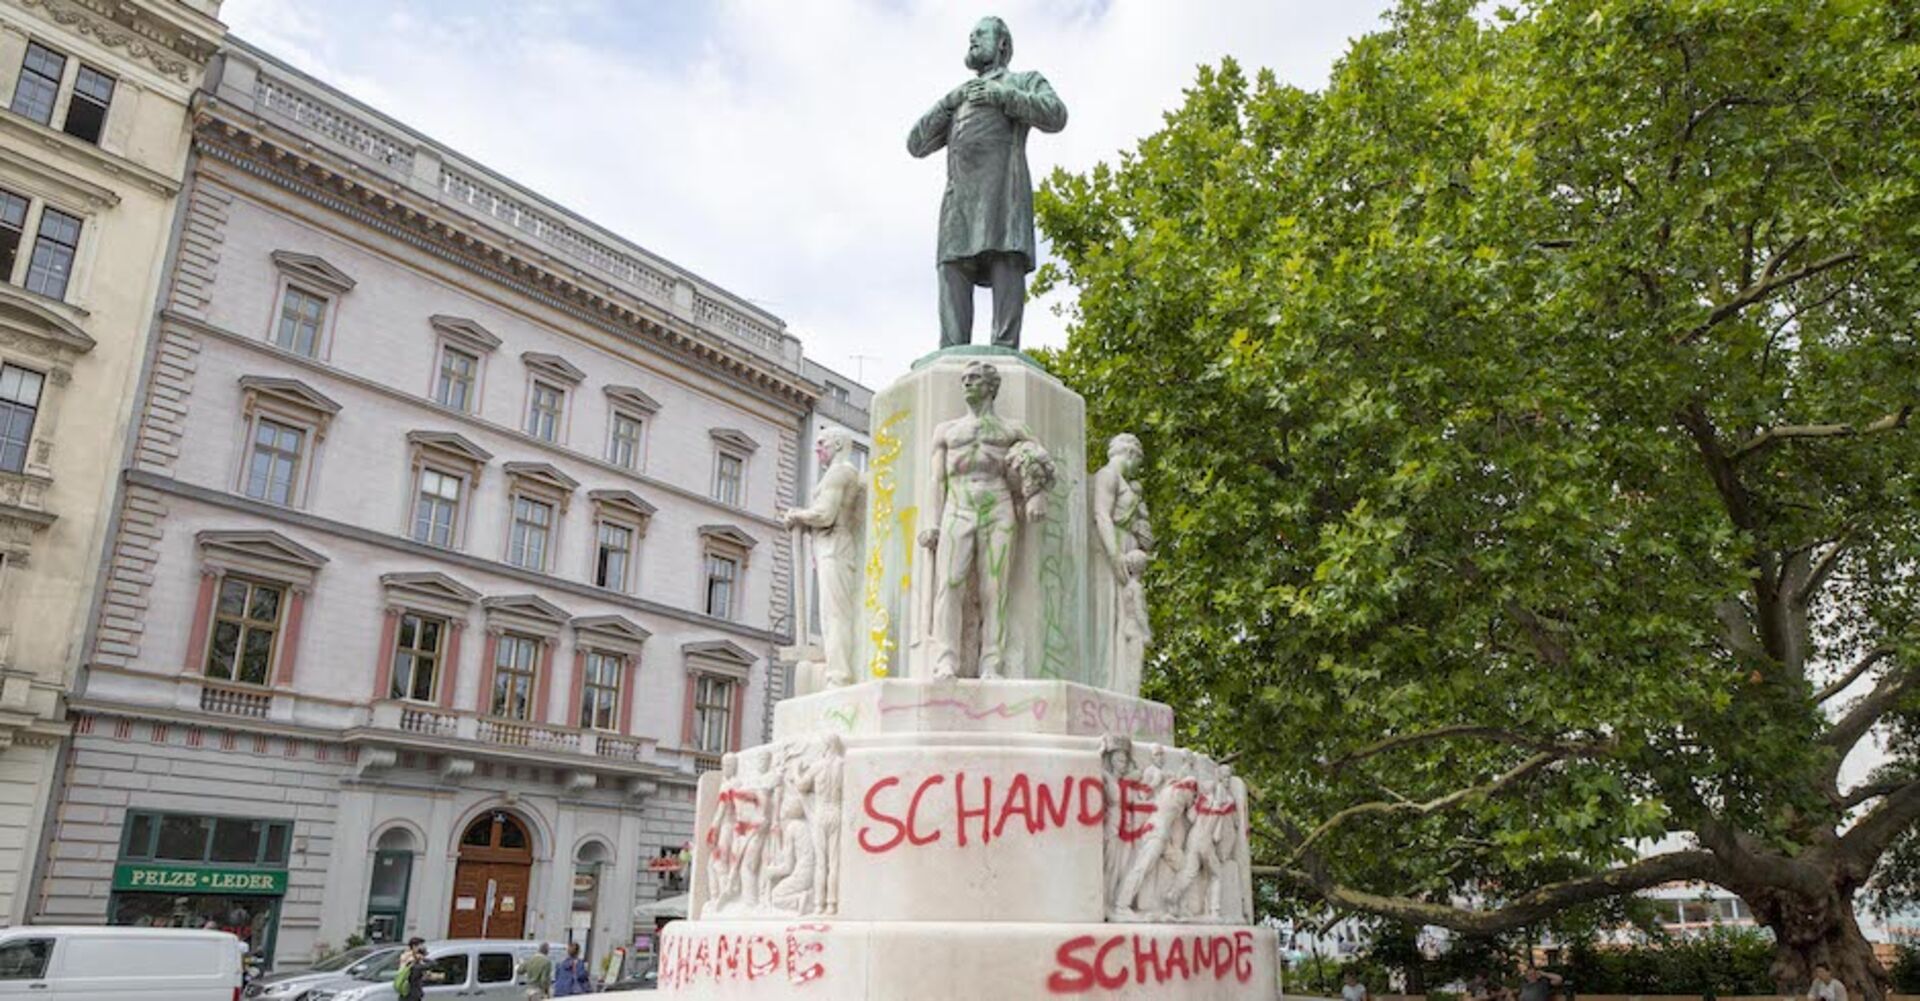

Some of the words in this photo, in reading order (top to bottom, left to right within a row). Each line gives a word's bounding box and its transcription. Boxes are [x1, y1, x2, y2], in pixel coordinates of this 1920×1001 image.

[858, 773, 1157, 853] SCHANDE
[131, 870, 197, 887] PELZE
[211, 874, 274, 889] LEDER
[1047, 930, 1254, 993] SCHANDE
